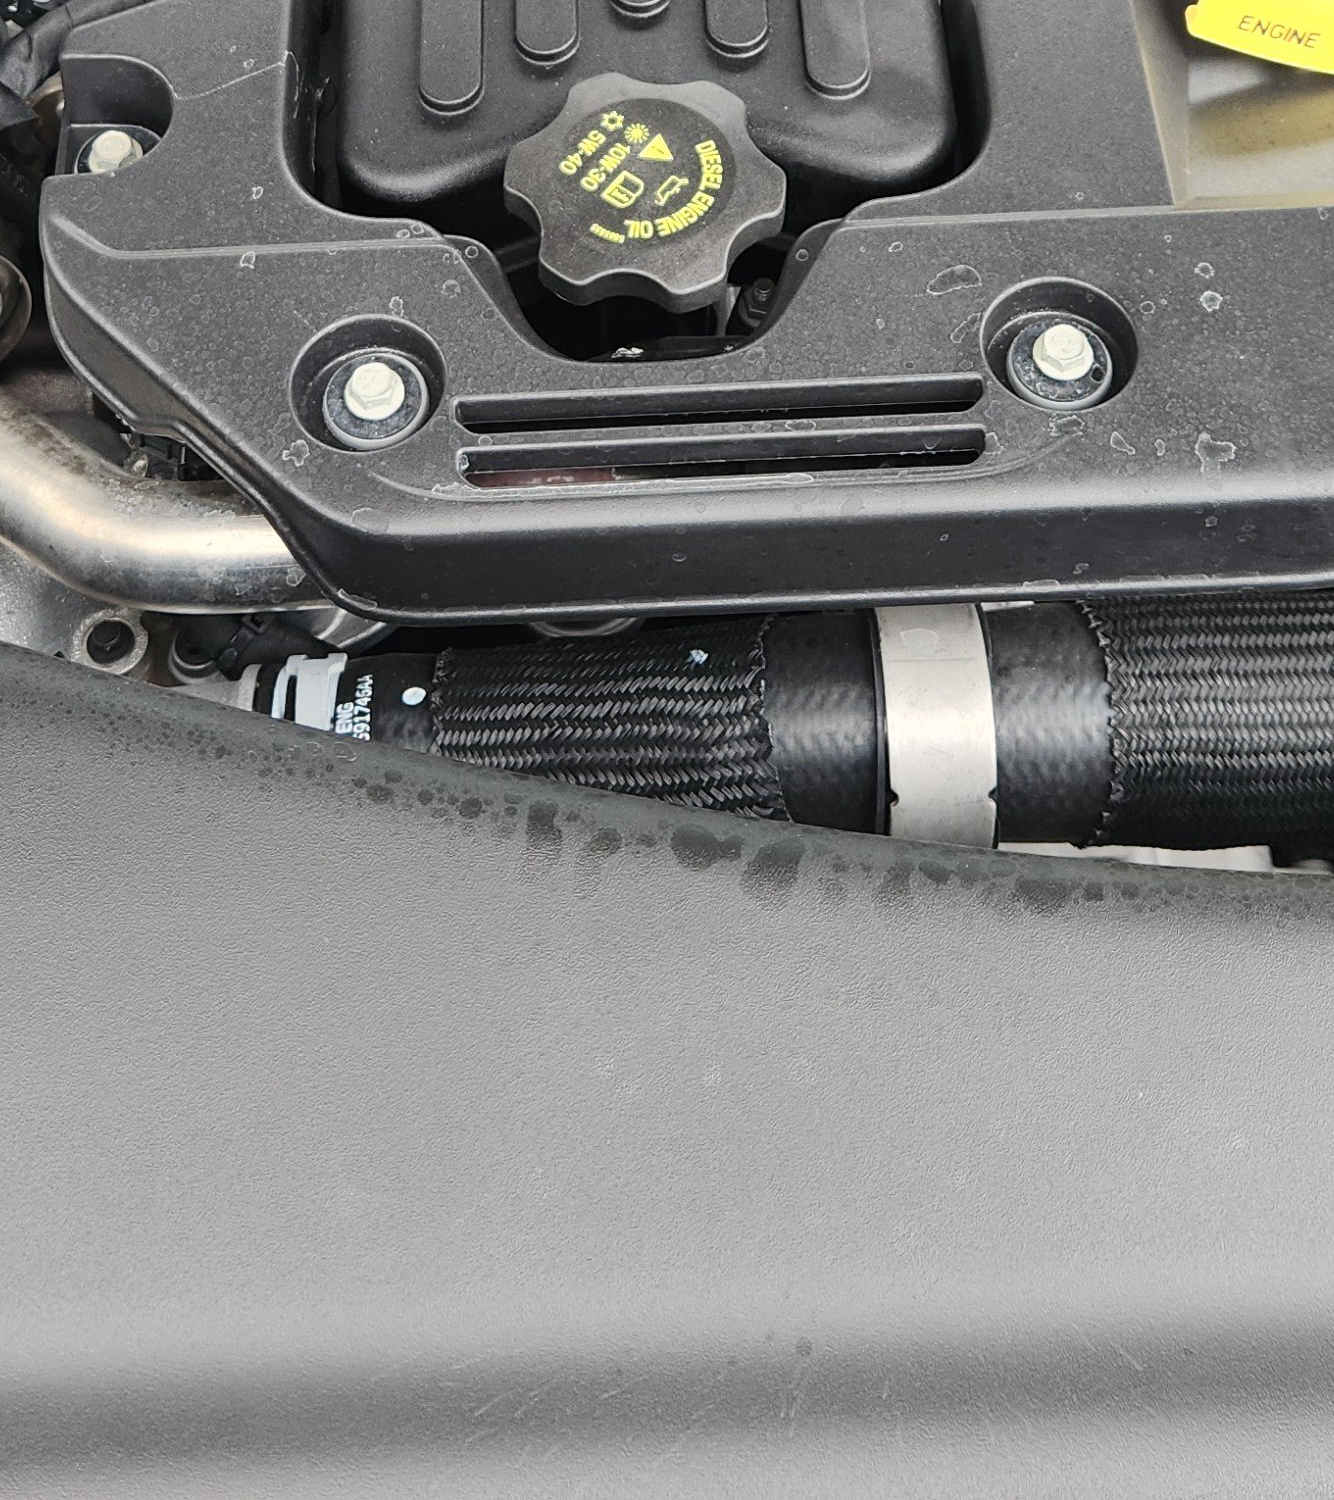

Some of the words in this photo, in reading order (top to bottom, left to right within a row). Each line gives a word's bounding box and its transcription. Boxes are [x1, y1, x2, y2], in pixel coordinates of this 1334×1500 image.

[1238, 14, 1321, 48] ENGINE
[559, 129, 606, 175] 5W-40
[580, 142, 631, 191] 10W-30
[695, 139, 723, 190] DIESEL
[624, 219, 654, 239] OIL
[655, 191, 715, 237] ENGINE
[335, 701, 354, 734] ENG
